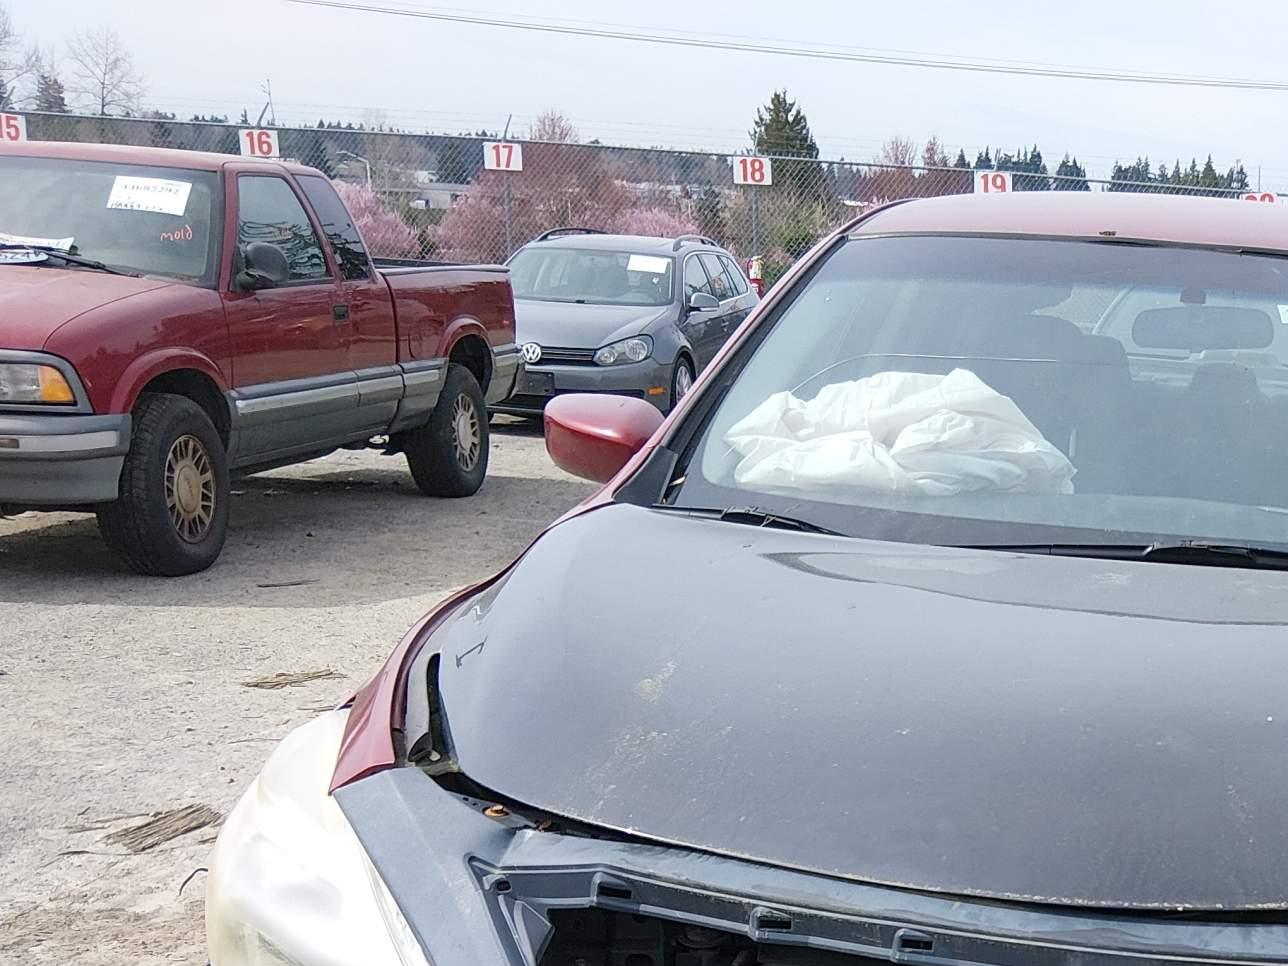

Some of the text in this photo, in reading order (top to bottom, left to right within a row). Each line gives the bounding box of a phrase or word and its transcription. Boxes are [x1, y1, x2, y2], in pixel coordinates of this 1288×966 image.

[246, 131, 273, 156] 16
[493, 144, 514, 168] 17
[739, 158, 766, 183] 18
[980, 173, 1007, 193] 19
[160, 224, 193, 241] mold
